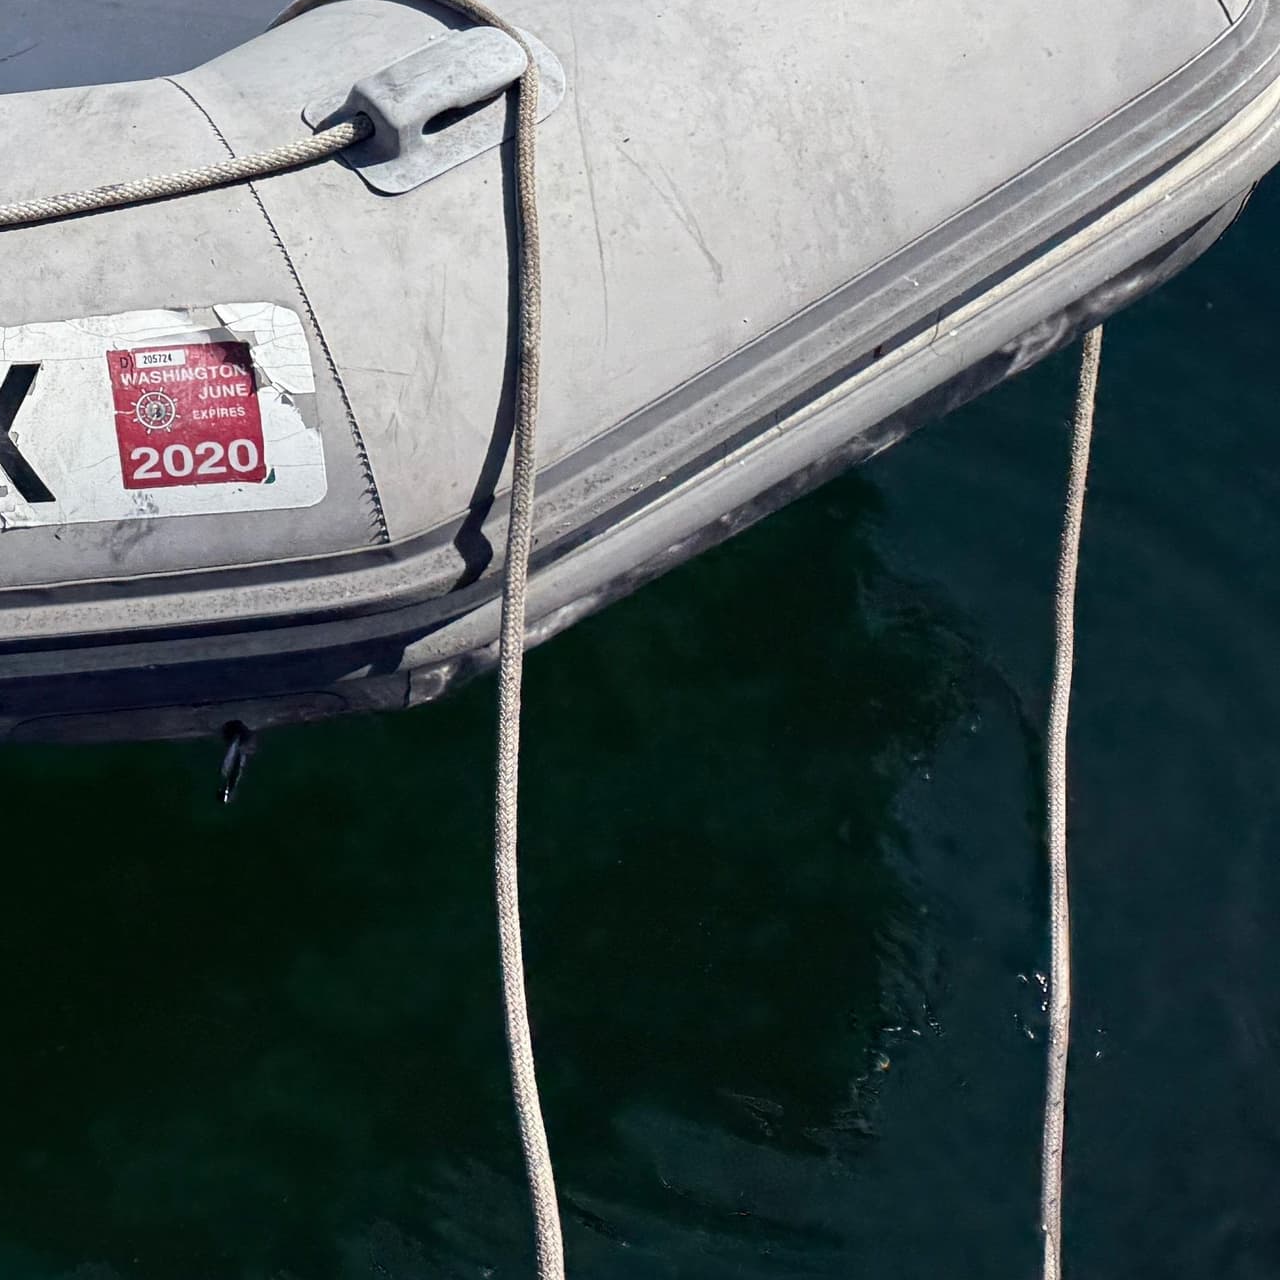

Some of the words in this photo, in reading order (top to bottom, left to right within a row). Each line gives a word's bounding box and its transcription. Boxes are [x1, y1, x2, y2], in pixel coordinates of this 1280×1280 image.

[143, 353, 173, 365] 205724
[120, 365, 247, 386] WASHINGTON
[198, 383, 249, 400] JUNE
[192, 406, 246, 421] EXPIRES
[130, 438, 259, 480] 2020
